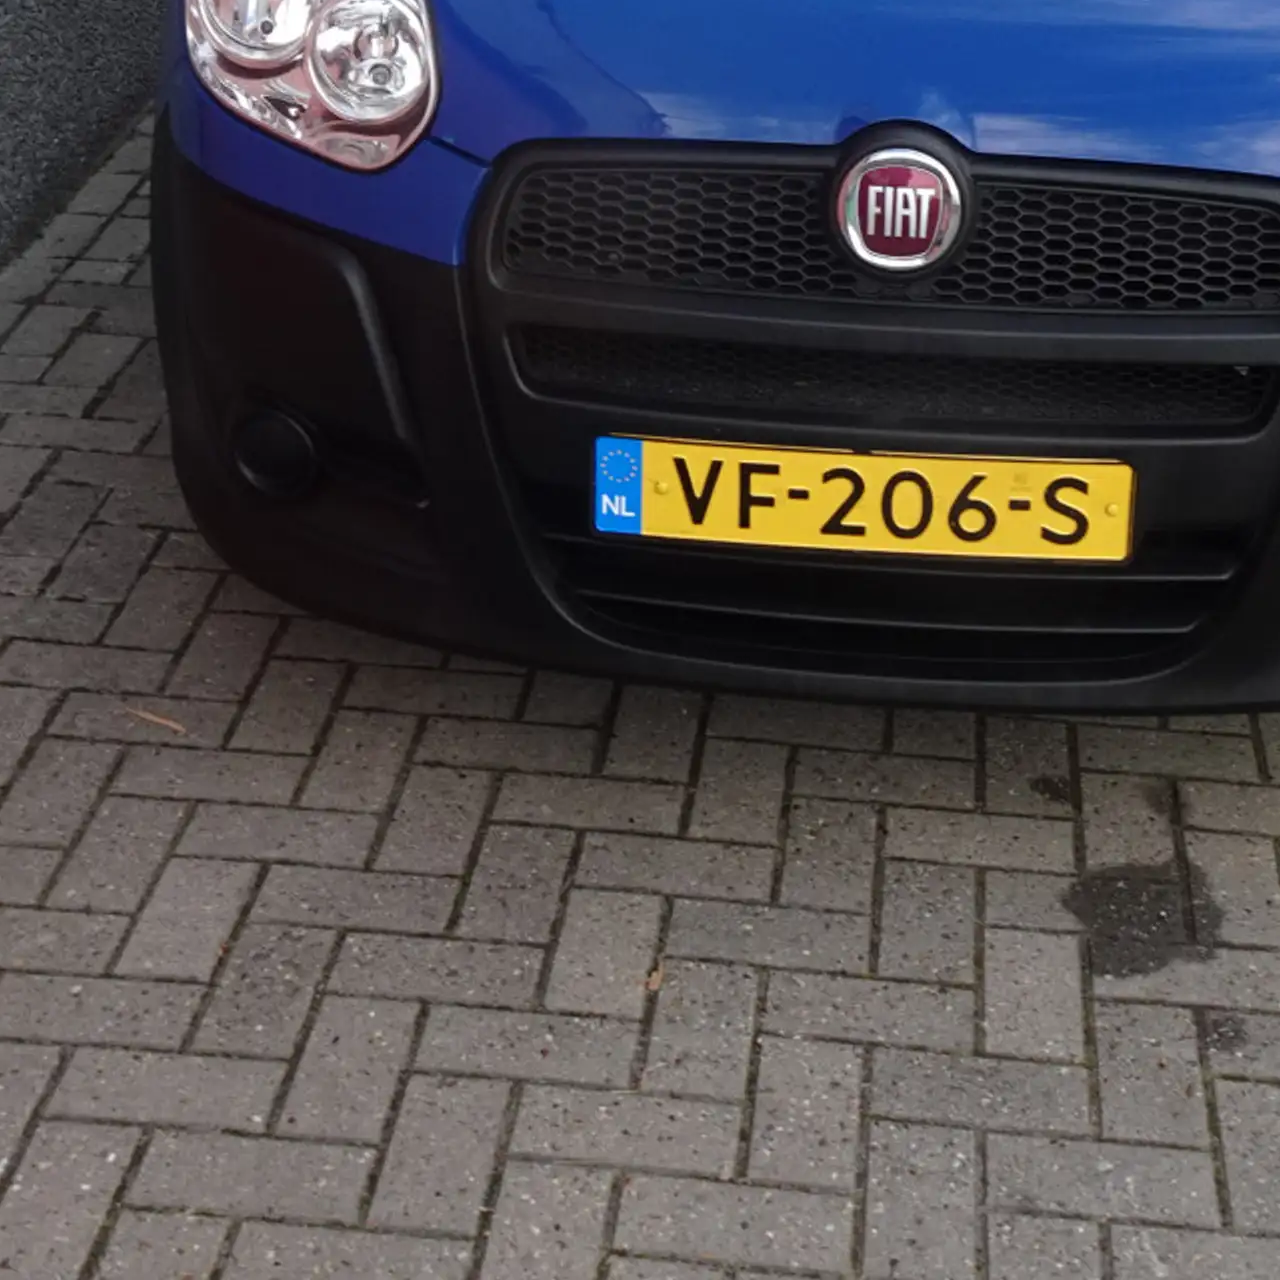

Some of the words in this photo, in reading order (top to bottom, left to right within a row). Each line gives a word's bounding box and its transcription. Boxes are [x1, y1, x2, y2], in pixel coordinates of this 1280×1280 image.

[866, 185, 936, 239] FIAT
[601, 495, 635, 518] NL
[672, 456, 1091, 546] VF-206-S
